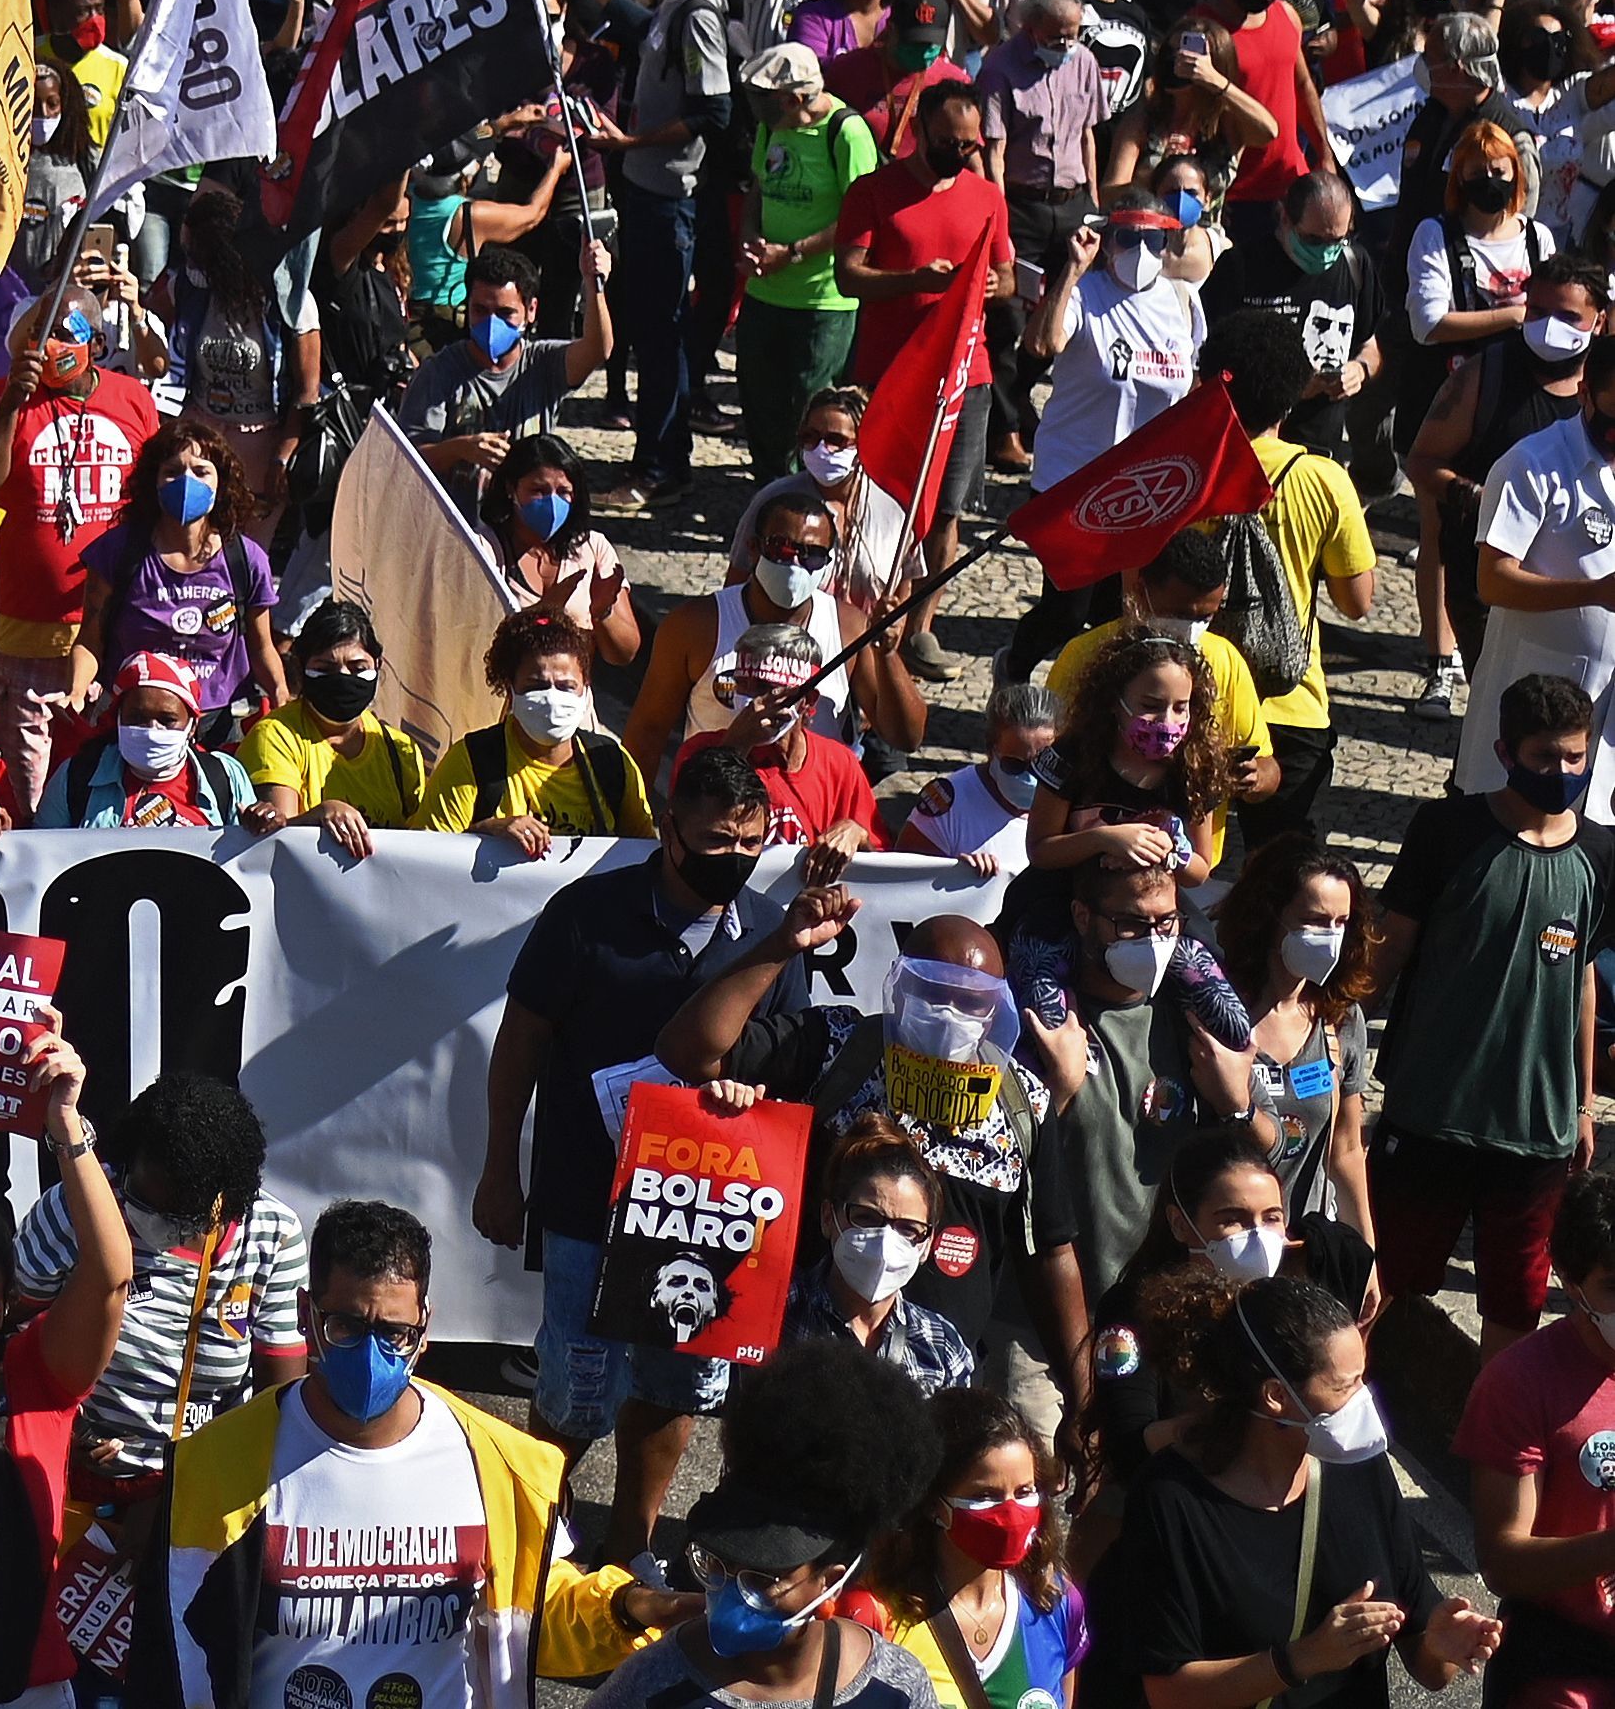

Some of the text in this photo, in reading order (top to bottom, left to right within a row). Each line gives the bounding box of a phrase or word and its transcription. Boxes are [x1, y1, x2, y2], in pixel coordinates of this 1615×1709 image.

[891, 1075, 983, 1130] GENOCIDA
[636, 1132, 761, 1182] FORA
[629, 1166, 785, 1222] BOLSO
[622, 1202, 766, 1269] NARO!
[734, 1343, 766, 1364] ptrj
[283, 1524, 458, 1568] A DEMOCRACIA
[56, 1560, 108, 1625] ERAL
[296, 1572, 446, 1593] COMEÇA PELOS
[70, 1574, 130, 1653] RRUBAR
[277, 1593, 461, 1647] MULAMBOS
